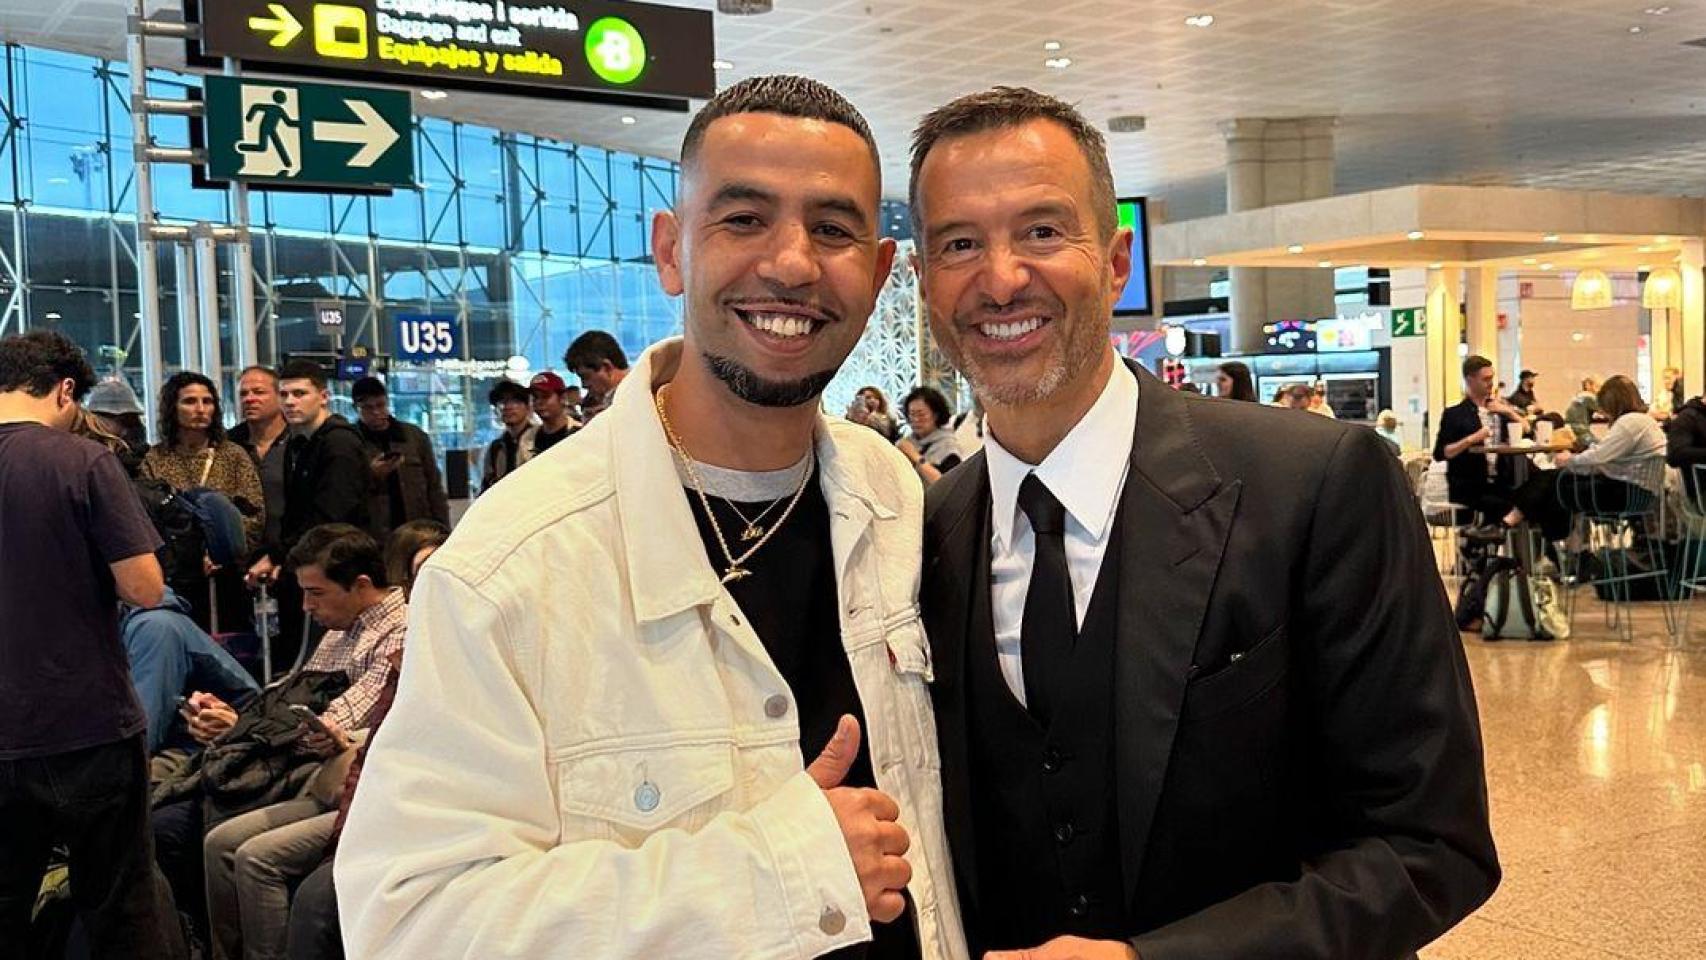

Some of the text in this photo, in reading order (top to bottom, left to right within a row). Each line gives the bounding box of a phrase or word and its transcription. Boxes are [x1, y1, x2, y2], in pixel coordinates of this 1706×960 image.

[378, 36, 563, 76] Equipajes y salida
[321, 310, 342, 325] U35
[401, 320, 453, 353] U35
